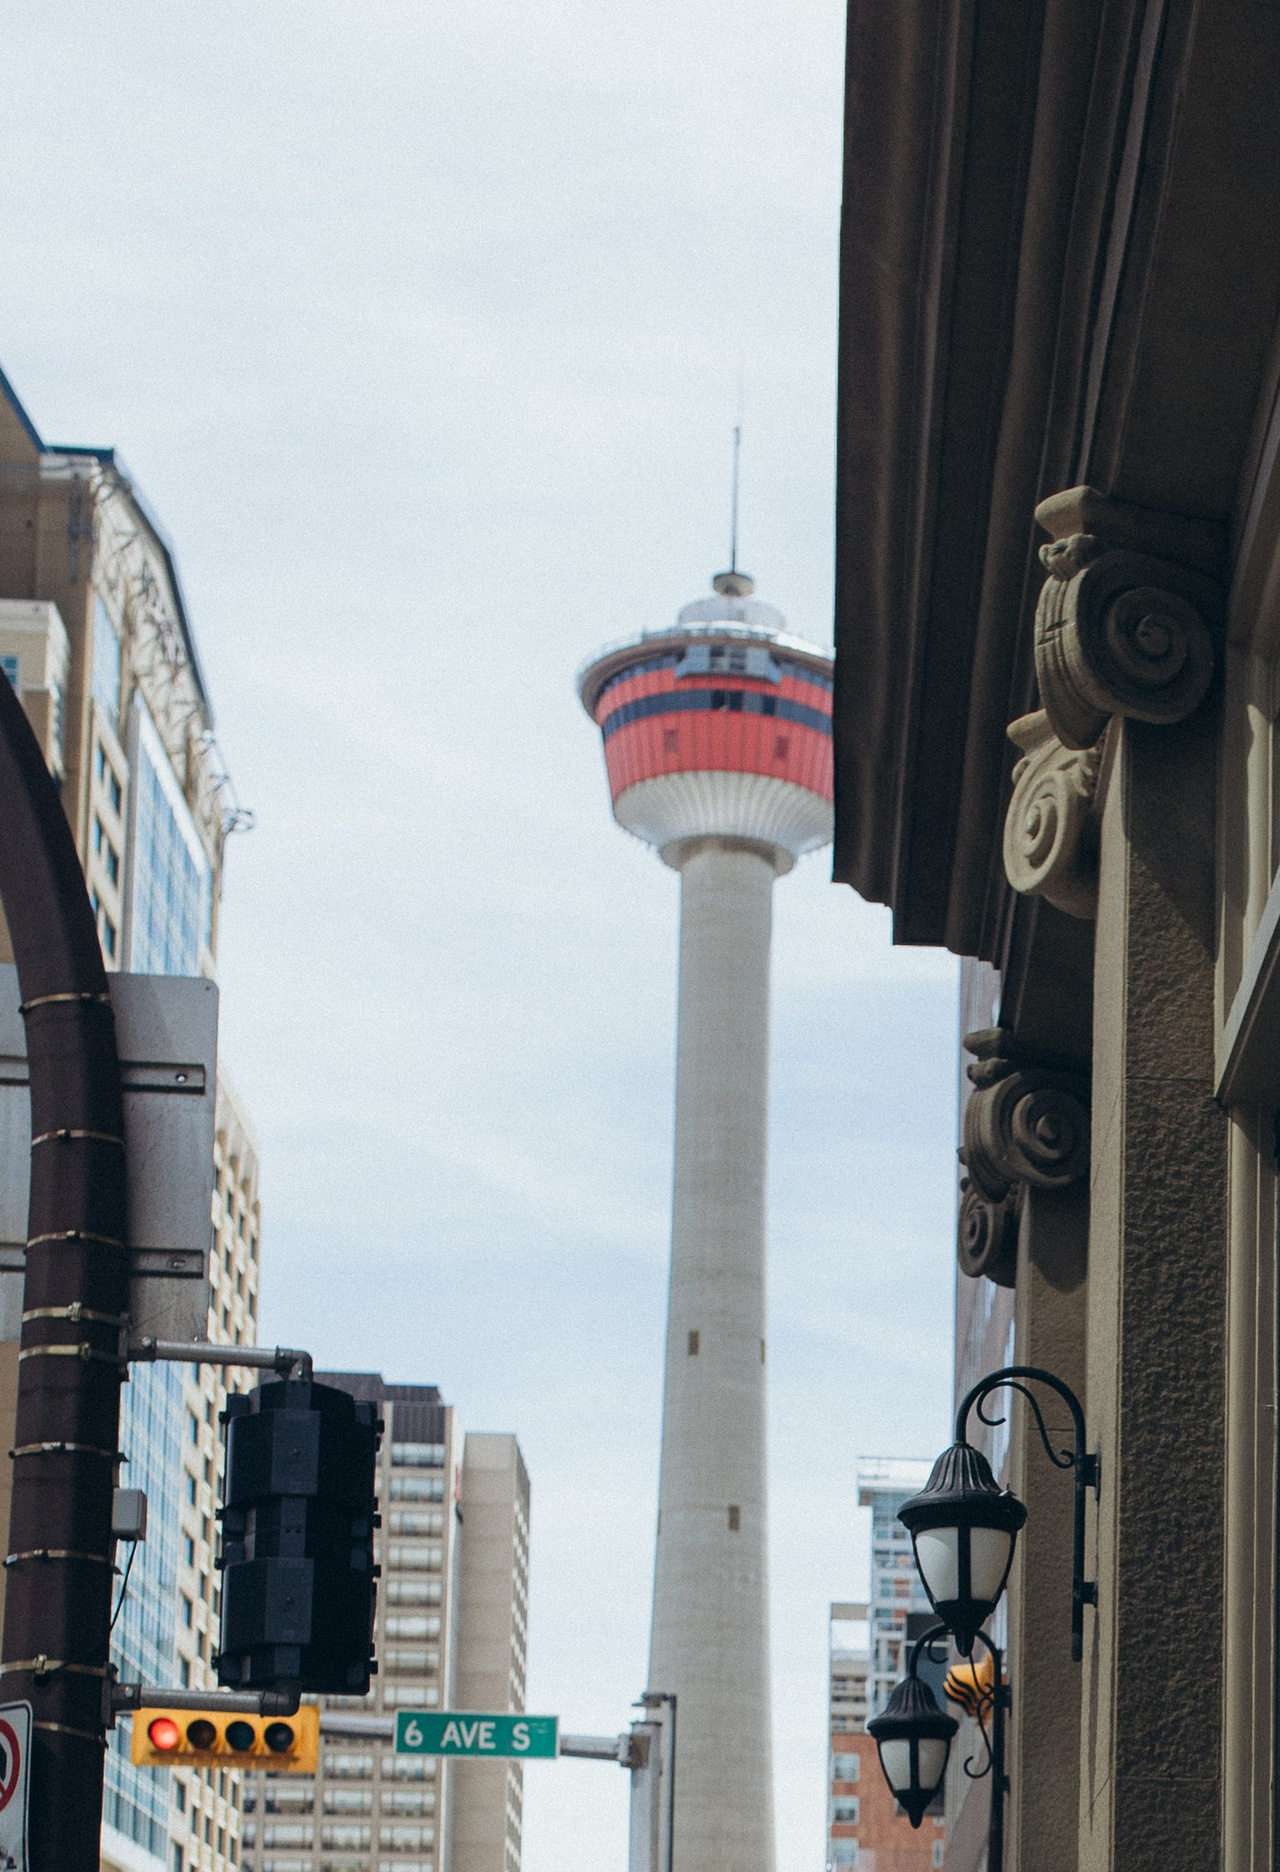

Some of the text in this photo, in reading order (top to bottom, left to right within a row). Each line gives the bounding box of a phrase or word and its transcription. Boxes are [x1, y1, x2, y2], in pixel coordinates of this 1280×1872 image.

[404, 1719, 423, 1747] 6
[440, 1721, 496, 1749] AVE
[511, 1722, 531, 1751] S
